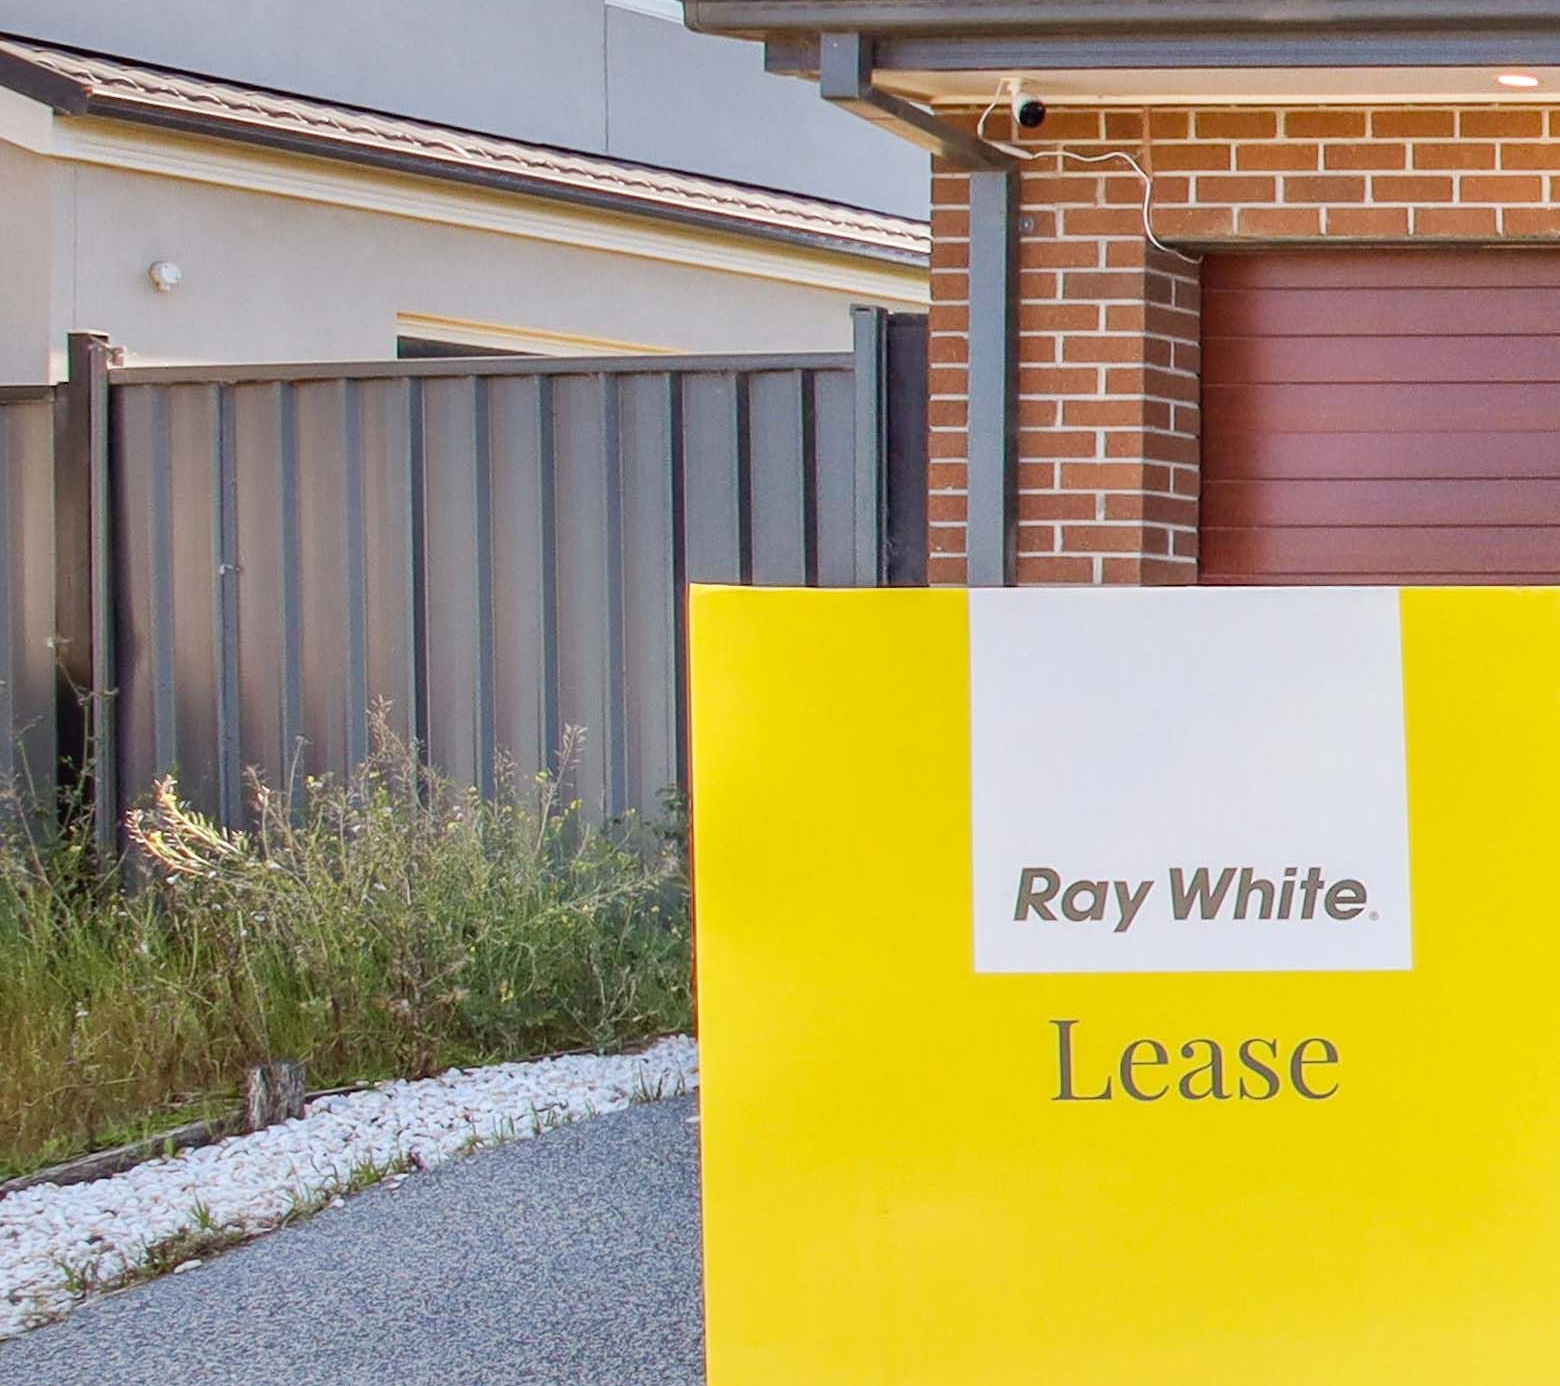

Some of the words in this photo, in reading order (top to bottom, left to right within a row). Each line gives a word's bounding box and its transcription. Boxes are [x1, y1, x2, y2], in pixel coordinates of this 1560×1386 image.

[1012, 866, 1155, 934] Ray
[1169, 865, 1368, 922] White
[1048, 1018, 1340, 1102] Lease
